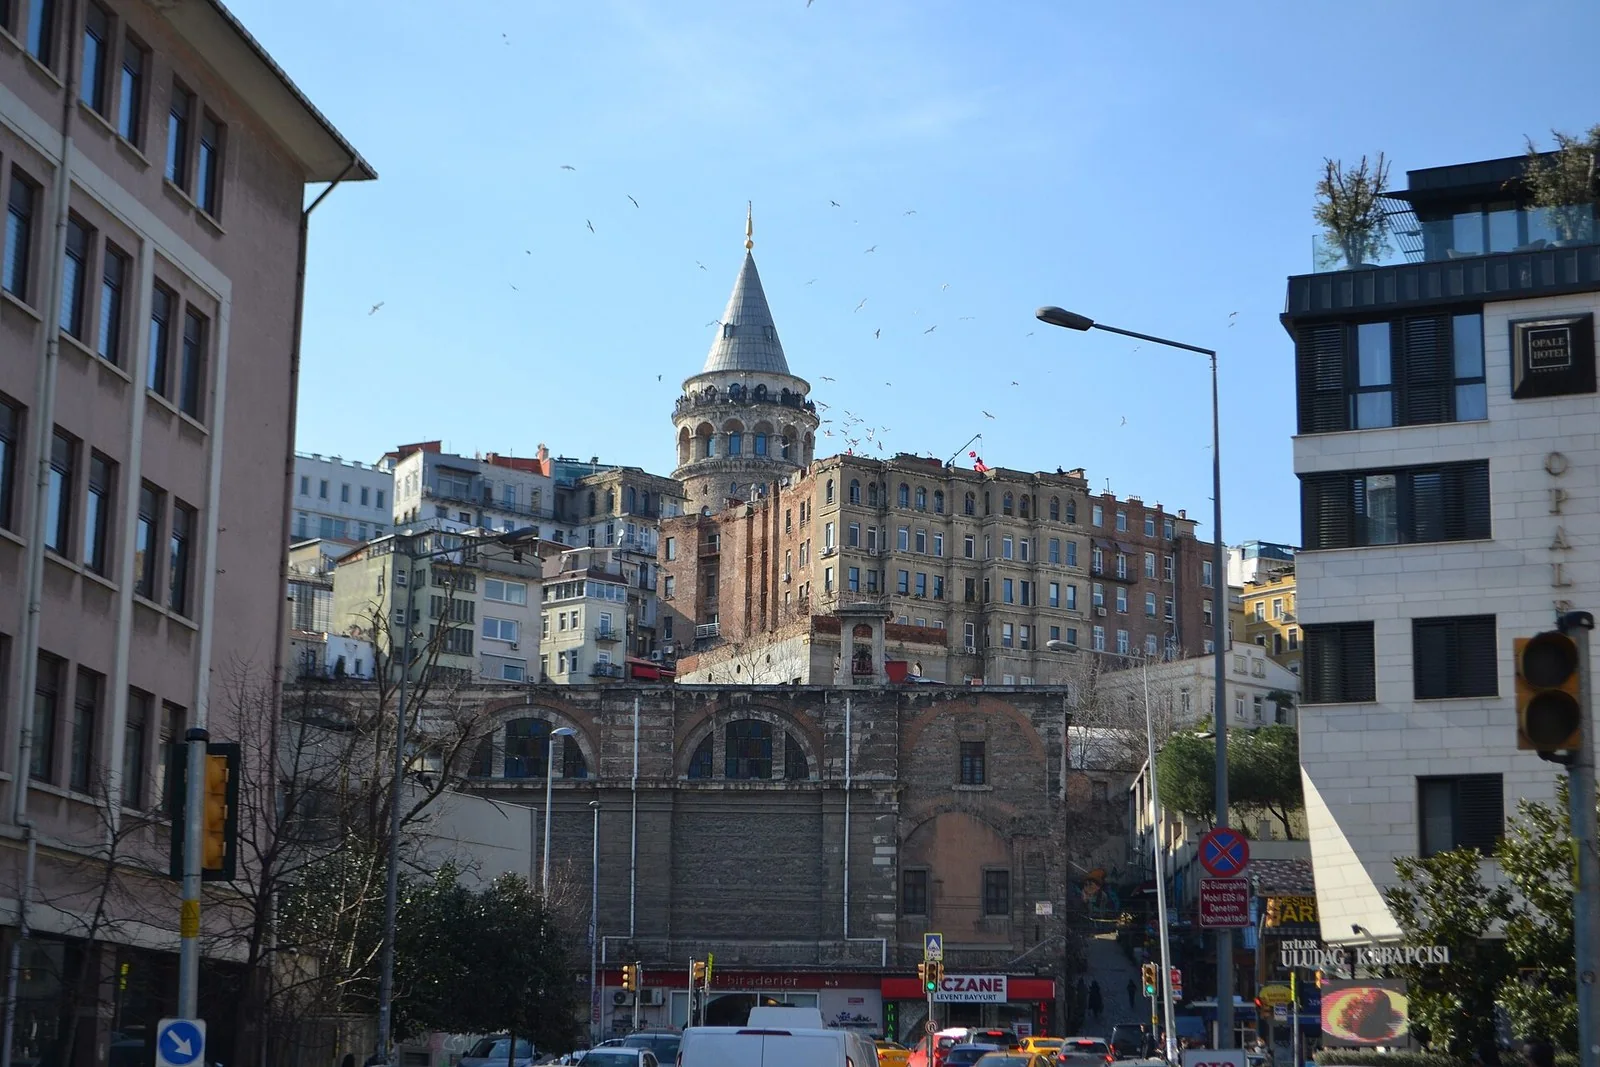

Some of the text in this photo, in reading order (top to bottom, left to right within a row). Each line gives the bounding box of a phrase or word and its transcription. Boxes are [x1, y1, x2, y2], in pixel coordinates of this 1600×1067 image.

[1532, 337, 1565, 347] OPALE
[1533, 349, 1567, 359] HOTEL
[1201, 880, 1210, 890] Bu
[1203, 893, 1221, 902] Mobil
[1222, 893, 1236, 902] EDS
[1210, 904, 1239, 912] Denetim
[1281, 938, 1318, 949] ETİLER
[1355, 945, 1450, 967] KEBAPÇISI
[938, 977, 1004, 992] CZANE
[936, 993, 961, 1001] LEVENT
